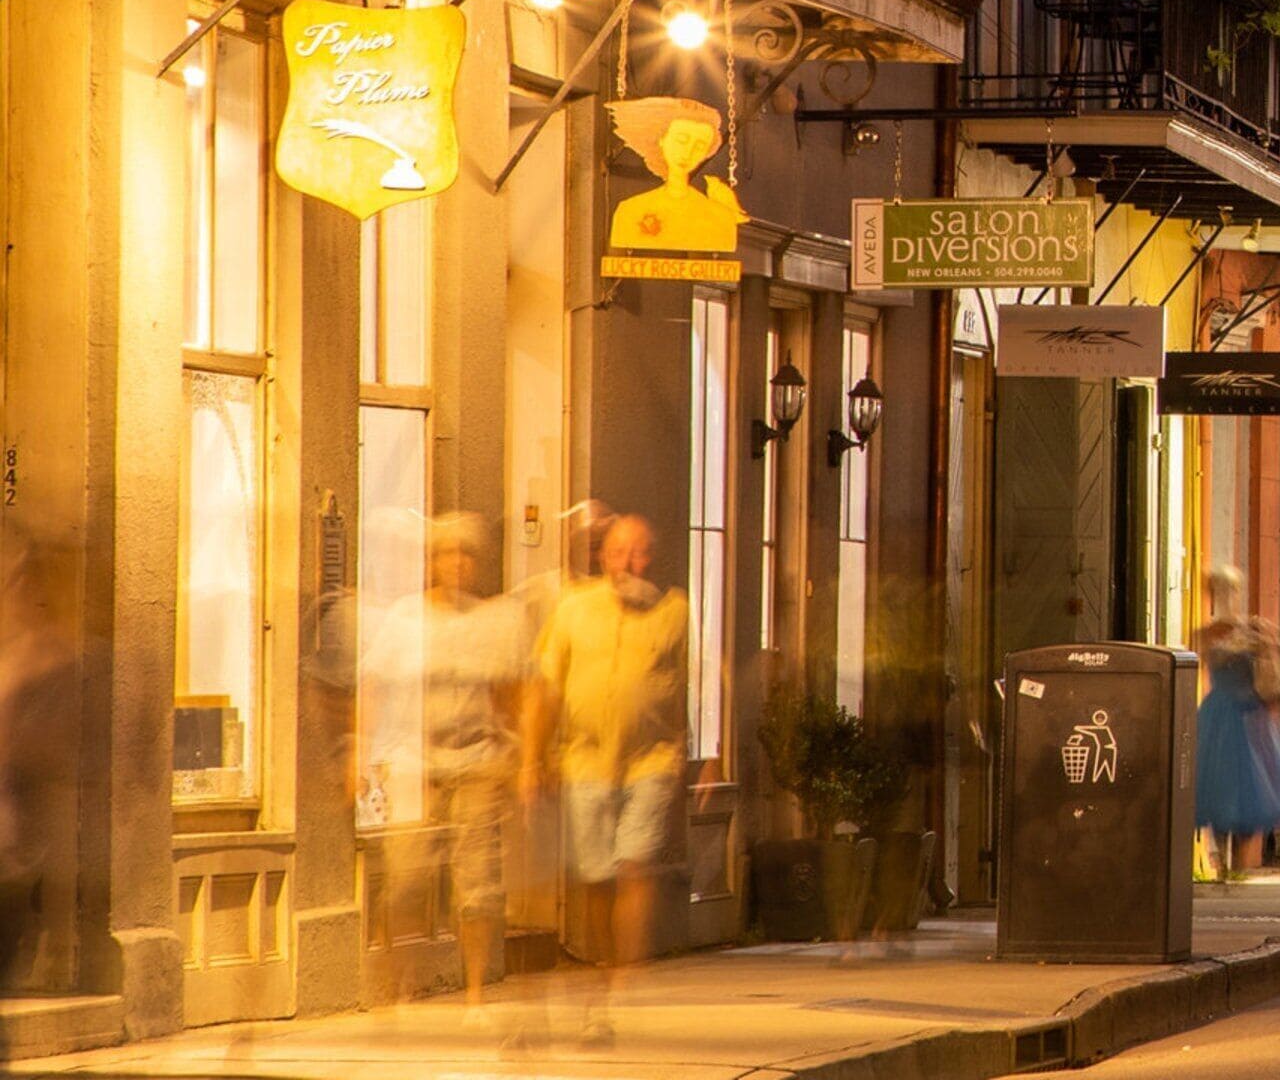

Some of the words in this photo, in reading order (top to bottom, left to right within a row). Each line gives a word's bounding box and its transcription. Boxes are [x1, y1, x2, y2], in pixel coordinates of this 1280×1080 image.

[295, 21, 394, 65] Papier
[326, 69, 429, 106] Plume
[863, 217, 877, 275] AVEDA
[907, 268, 930, 277] NEW
[934, 268, 981, 277] ORLEANS
[1048, 345, 1114, 354] TANNER
[1201, 387, 1262, 396] TANNER
[4, 449, 17, 506] 842
